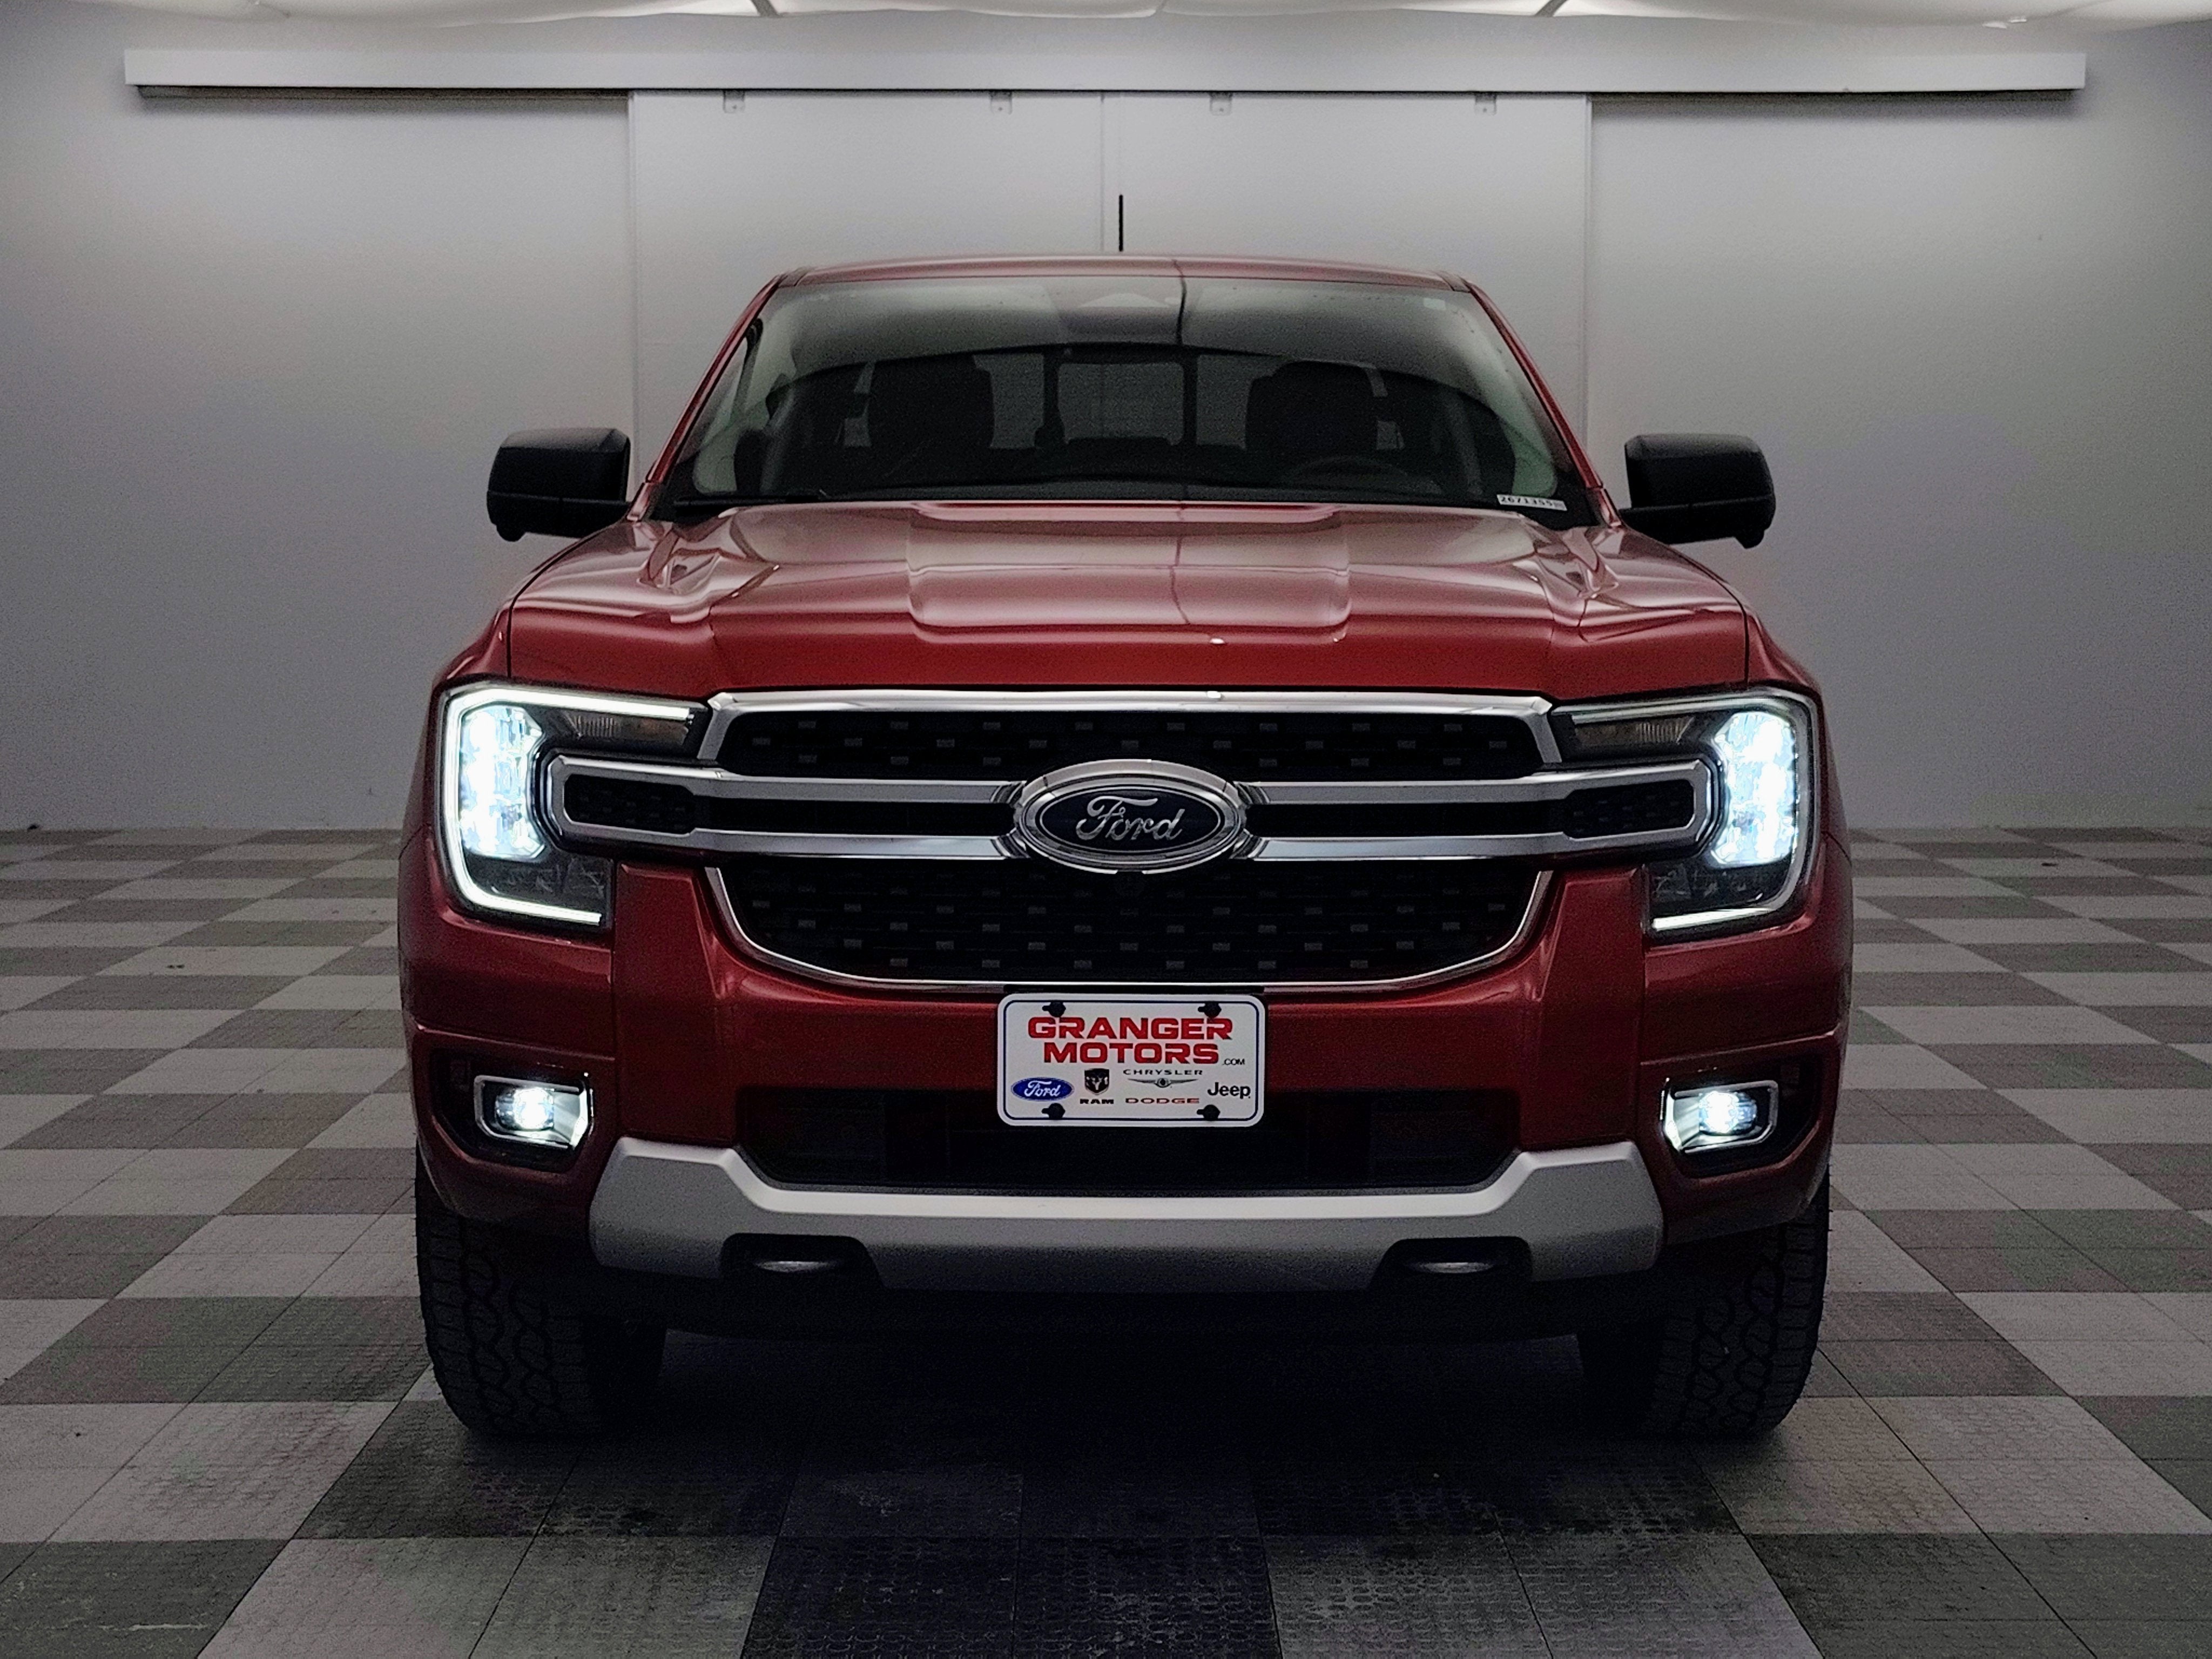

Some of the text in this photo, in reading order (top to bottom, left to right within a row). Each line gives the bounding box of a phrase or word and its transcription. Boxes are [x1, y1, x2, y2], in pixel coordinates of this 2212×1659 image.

[1076, 795, 1185, 840] Ford
[1028, 1017, 1233, 1040] GRANGER
[1044, 1042, 1219, 1064] MOTORS
[1024, 1080, 1061, 1097] Ford
[1208, 1082, 1251, 1099] Jeep
